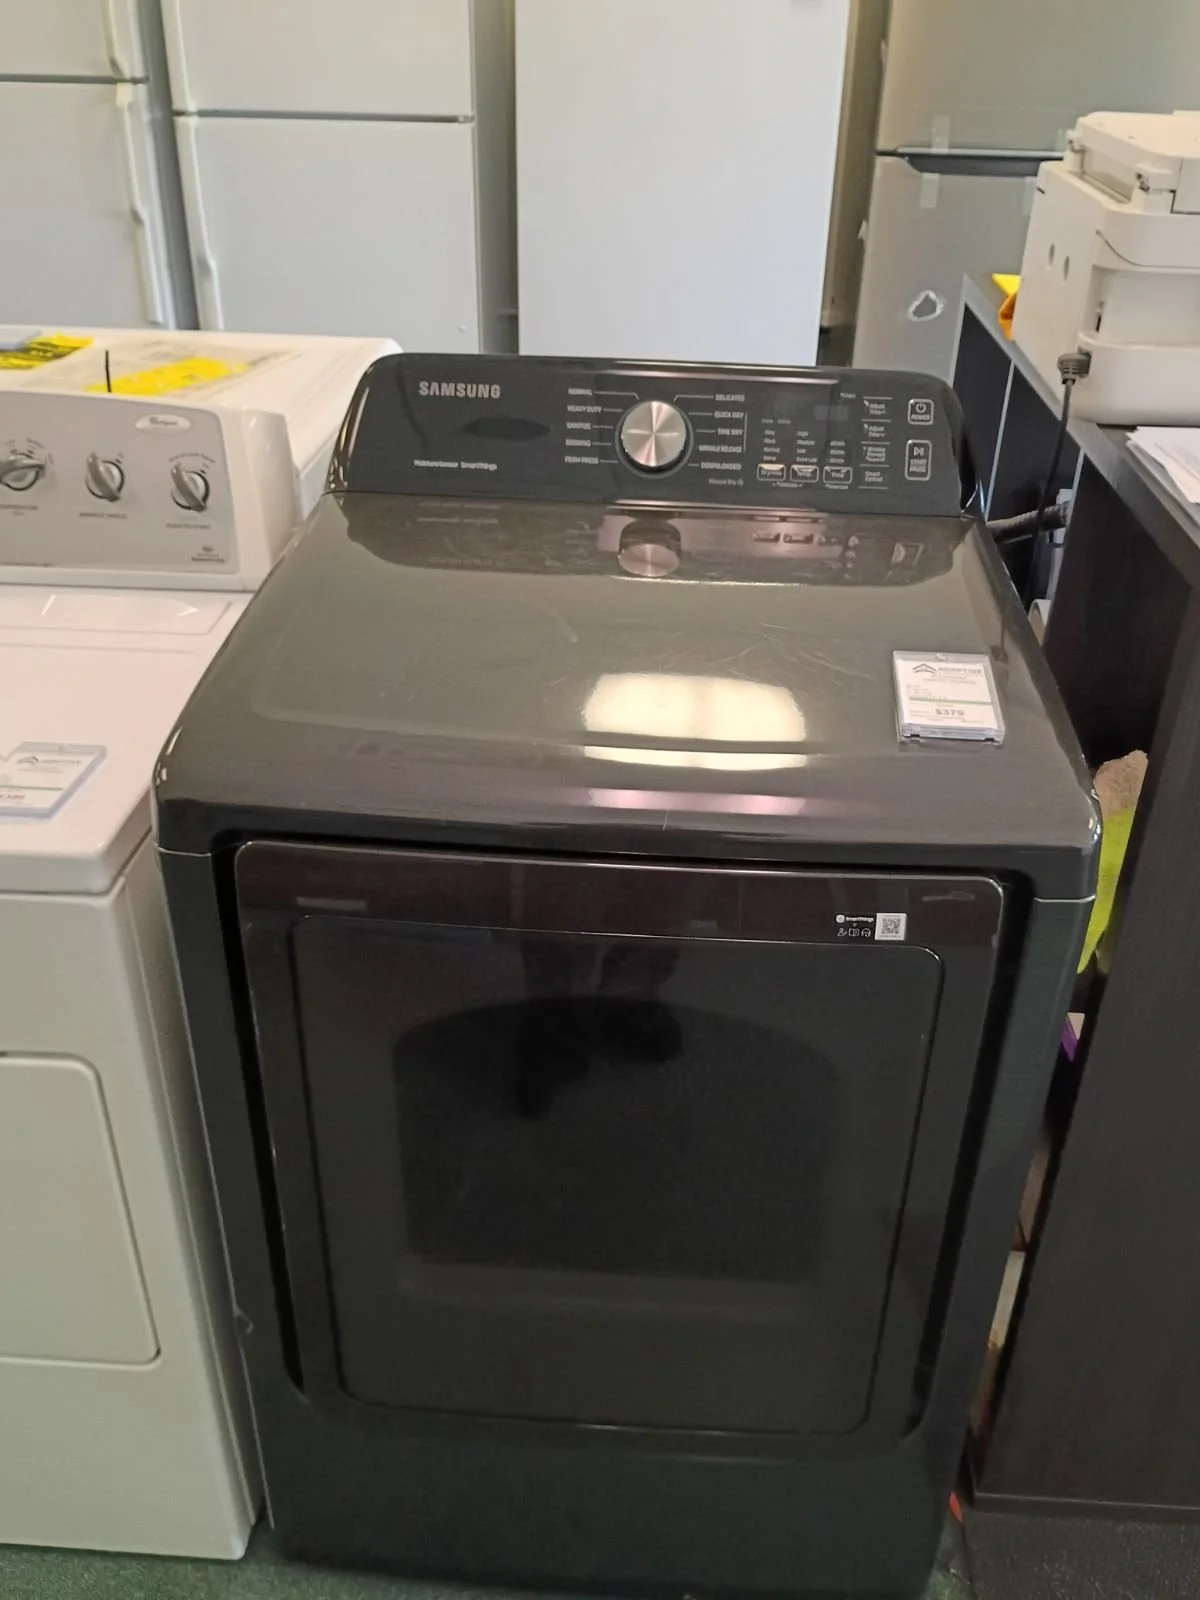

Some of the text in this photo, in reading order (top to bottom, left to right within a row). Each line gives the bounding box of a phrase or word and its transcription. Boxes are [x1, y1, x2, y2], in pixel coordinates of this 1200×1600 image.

[419, 381, 501, 399] SAMSUNG
[568, 388, 592, 396] NORMAL
[715, 393, 745, 402] DELICATES
[567, 404, 602, 413] HEAVY DUTY
[582, 456, 599, 464] PRESS
